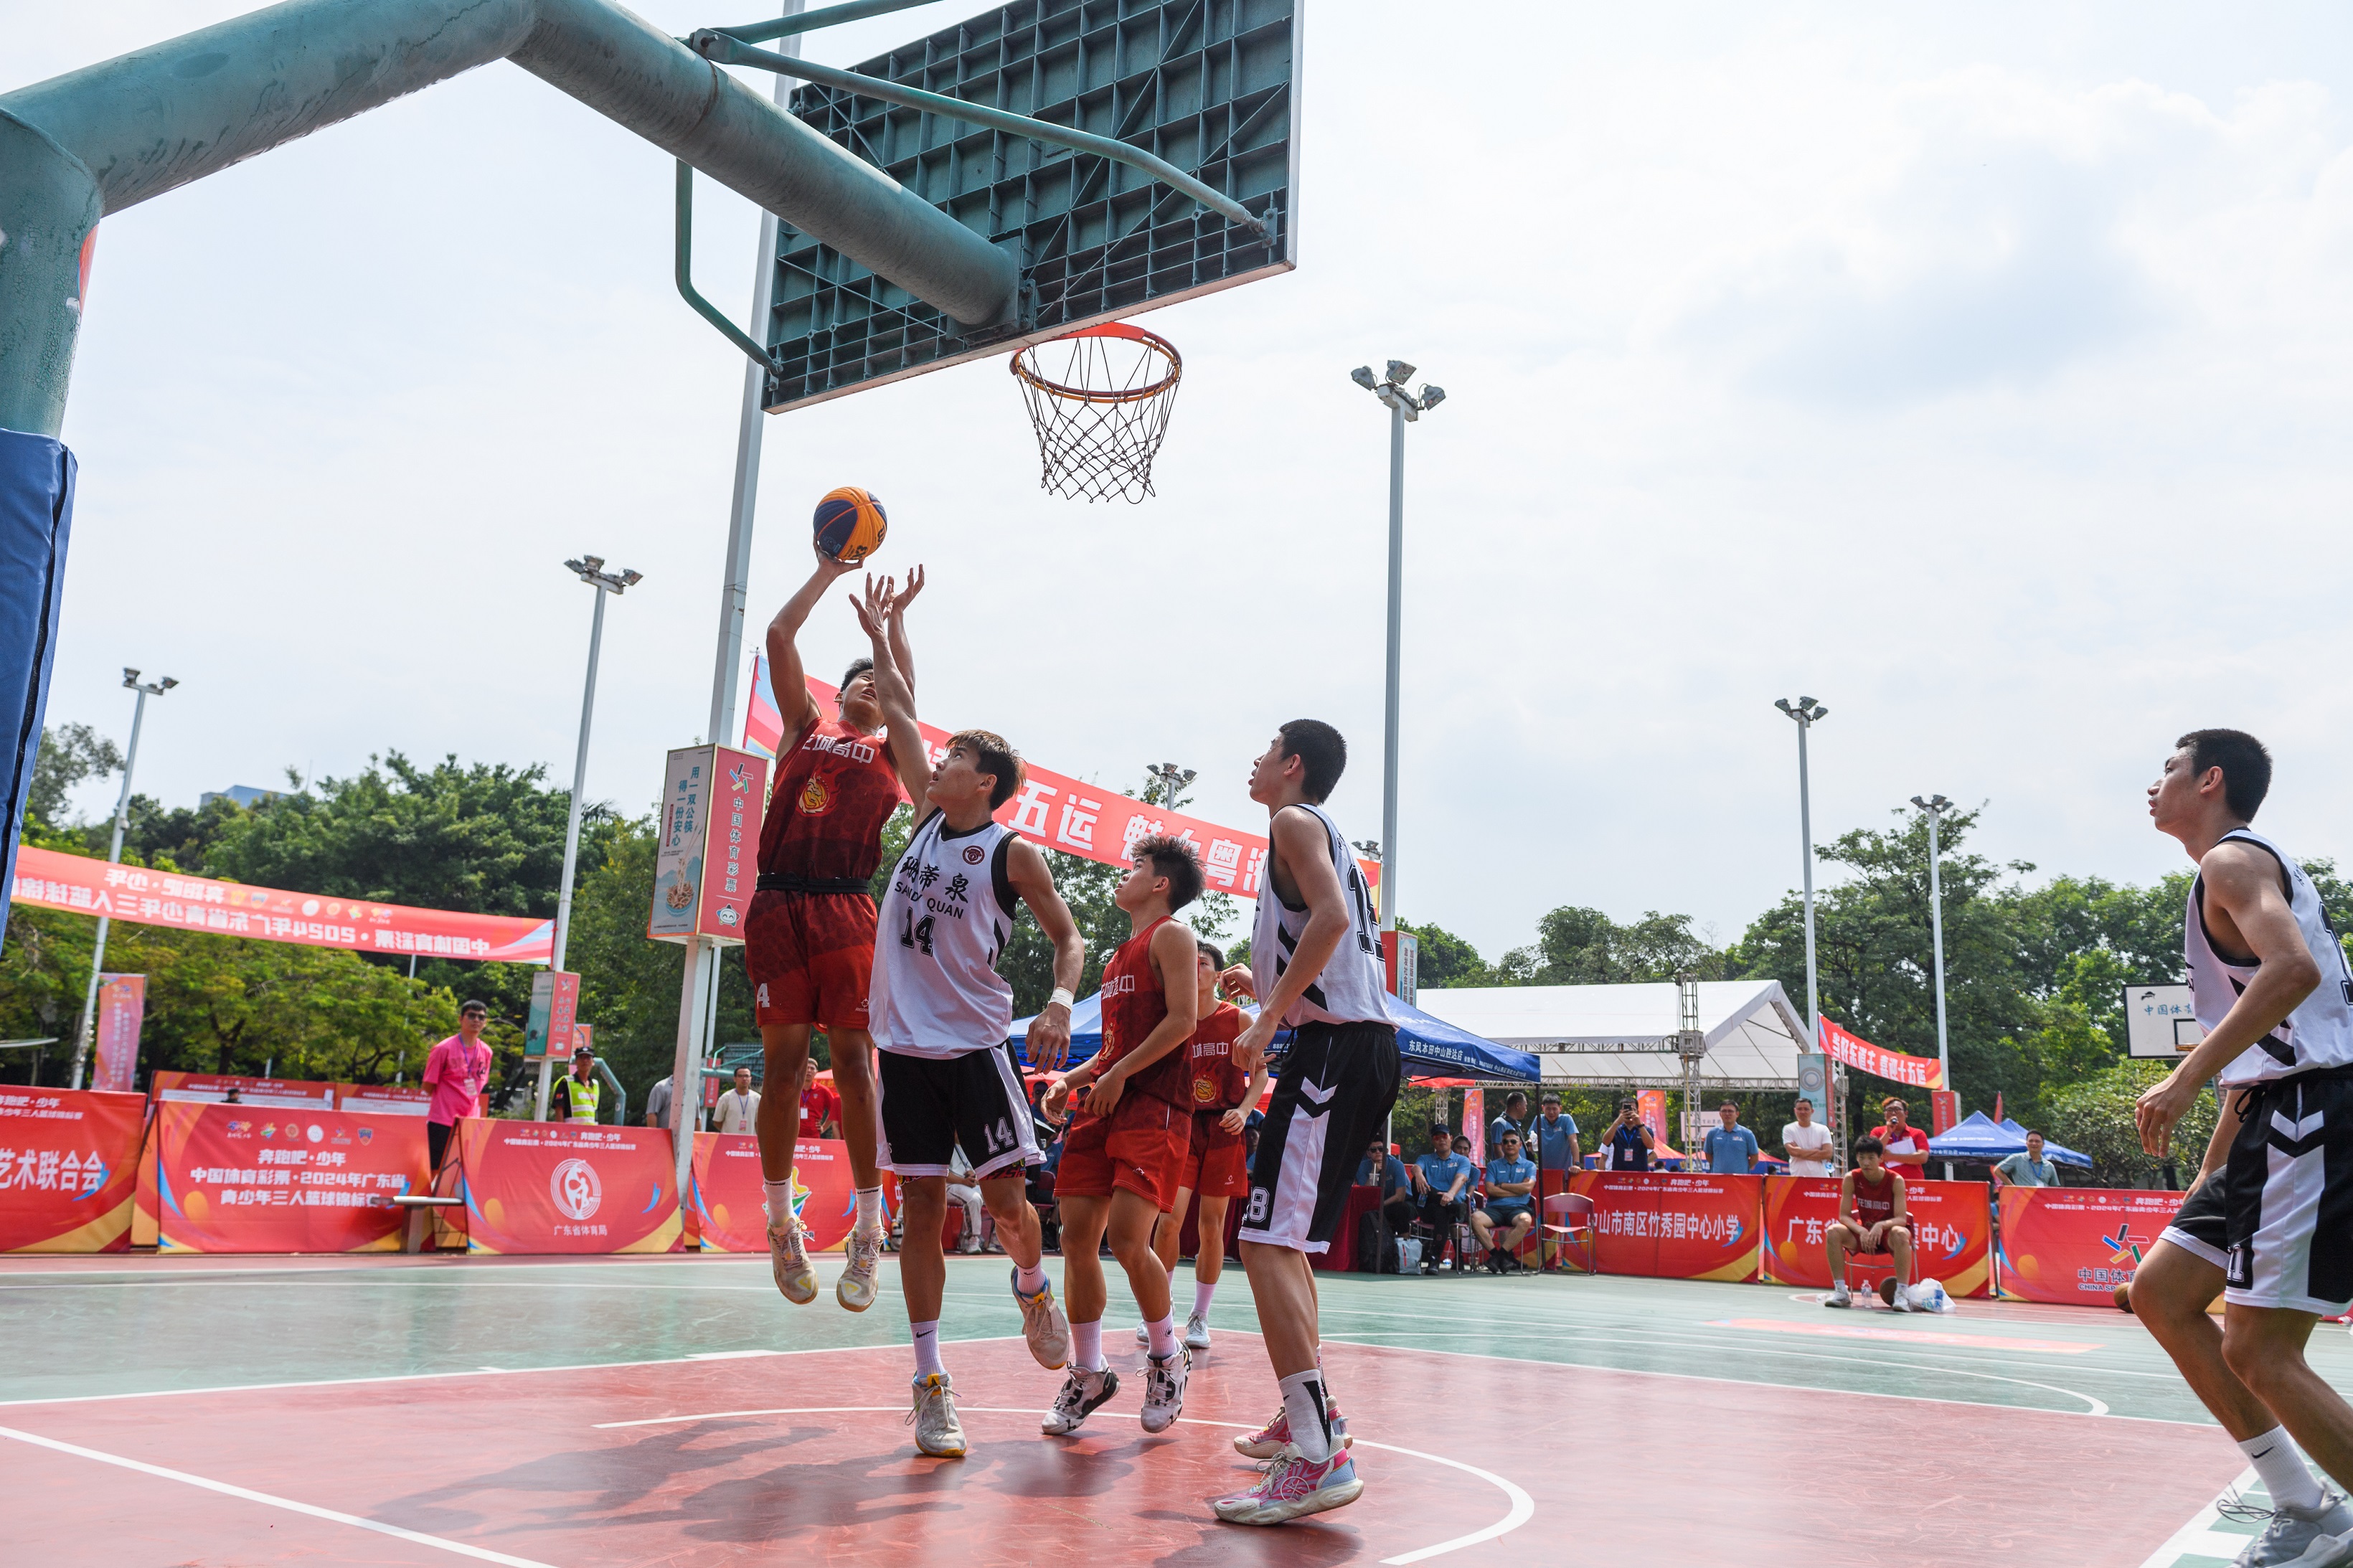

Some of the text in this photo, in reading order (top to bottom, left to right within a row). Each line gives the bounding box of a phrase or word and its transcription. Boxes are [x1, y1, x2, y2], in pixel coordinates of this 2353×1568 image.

[671, 780, 688, 846] 得一份安心
[684, 766, 700, 833] 用一双公筷
[725, 796, 744, 892] 中国体育彩票
[927, 898, 964, 920] QUAN
[900, 906, 935, 958] 14
[1408, 1039, 1463, 1061] 东风本田中山胜达店
[1831, 1031, 1927, 1085] 当好东道主 喜迎十五运
[984, 1116, 1016, 1155] 14
[0, 1148, 103, 1192] 艺术联合会
[257, 1148, 347, 1166] 奔跑吧·少年
[189, 1167, 406, 1189] 中国体育彩票·2024年广东省
[1242, 1186, 1270, 1224] 8
[554, 1224, 608, 1237] 广东省体育局
[1587, 1209, 1740, 1242] 中山市南区竹秀园中心小学
[2079, 1283, 2103, 1292] CHINA
